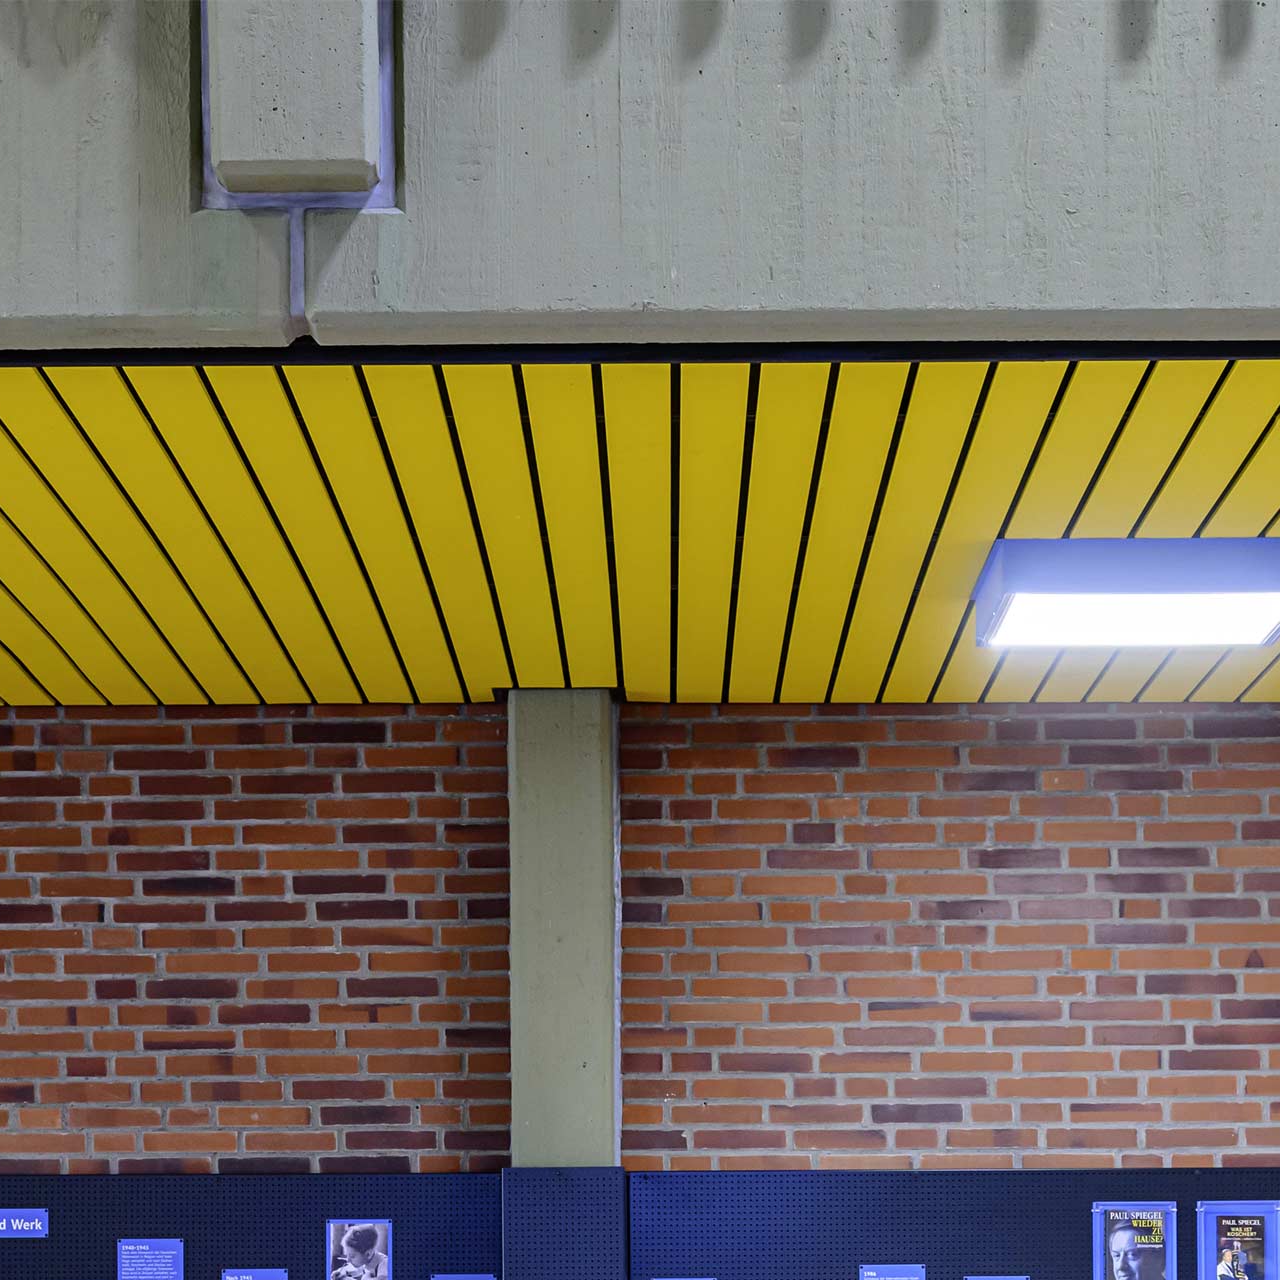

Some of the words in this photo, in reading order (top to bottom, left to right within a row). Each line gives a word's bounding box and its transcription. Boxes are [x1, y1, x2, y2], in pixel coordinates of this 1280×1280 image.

[1110, 1211, 1129, 1220] PAUL
[1131, 1211, 1163, 1220] SPIEGEL
[10, 1218, 42, 1230] Werk
[1131, 1220, 1163, 1228] WIEDER
[1134, 1236, 1163, 1244] HAUSE?
